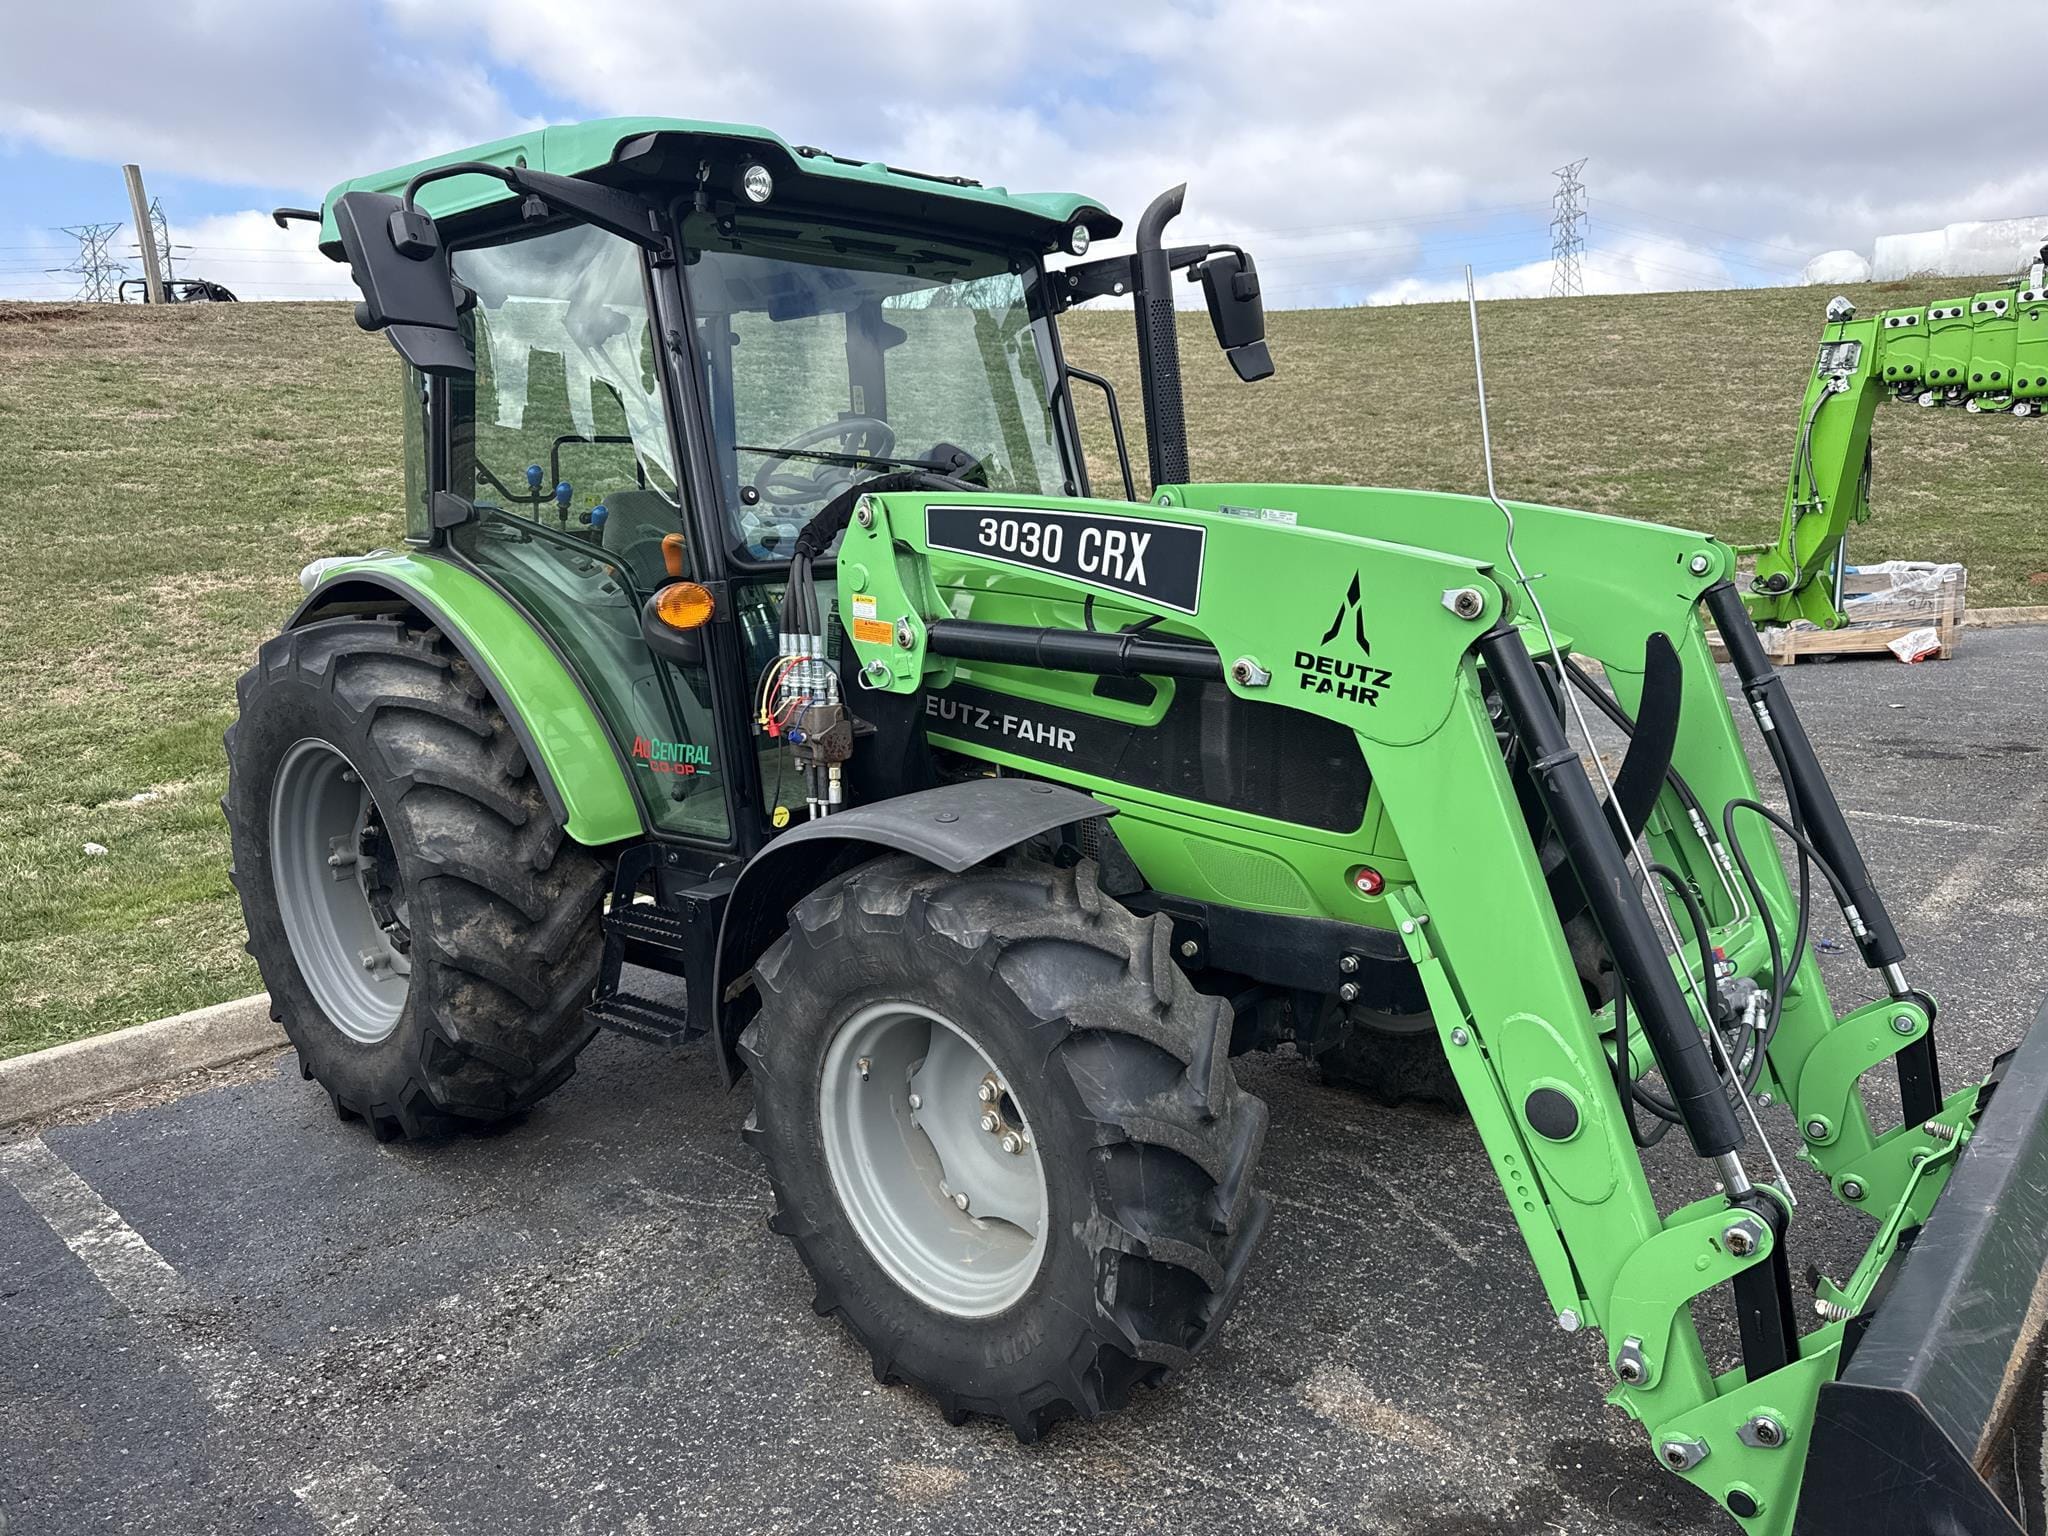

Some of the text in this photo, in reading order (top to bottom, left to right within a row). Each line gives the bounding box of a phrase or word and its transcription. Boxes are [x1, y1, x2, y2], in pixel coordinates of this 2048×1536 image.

[979, 518, 1152, 587] 3030 CRX
[1294, 650, 1393, 689] DEUTZ
[1300, 672, 1380, 708] FAHR
[925, 694, 1077, 752] EUTZ-FAHR
[649, 760, 695, 775] CO-OP
